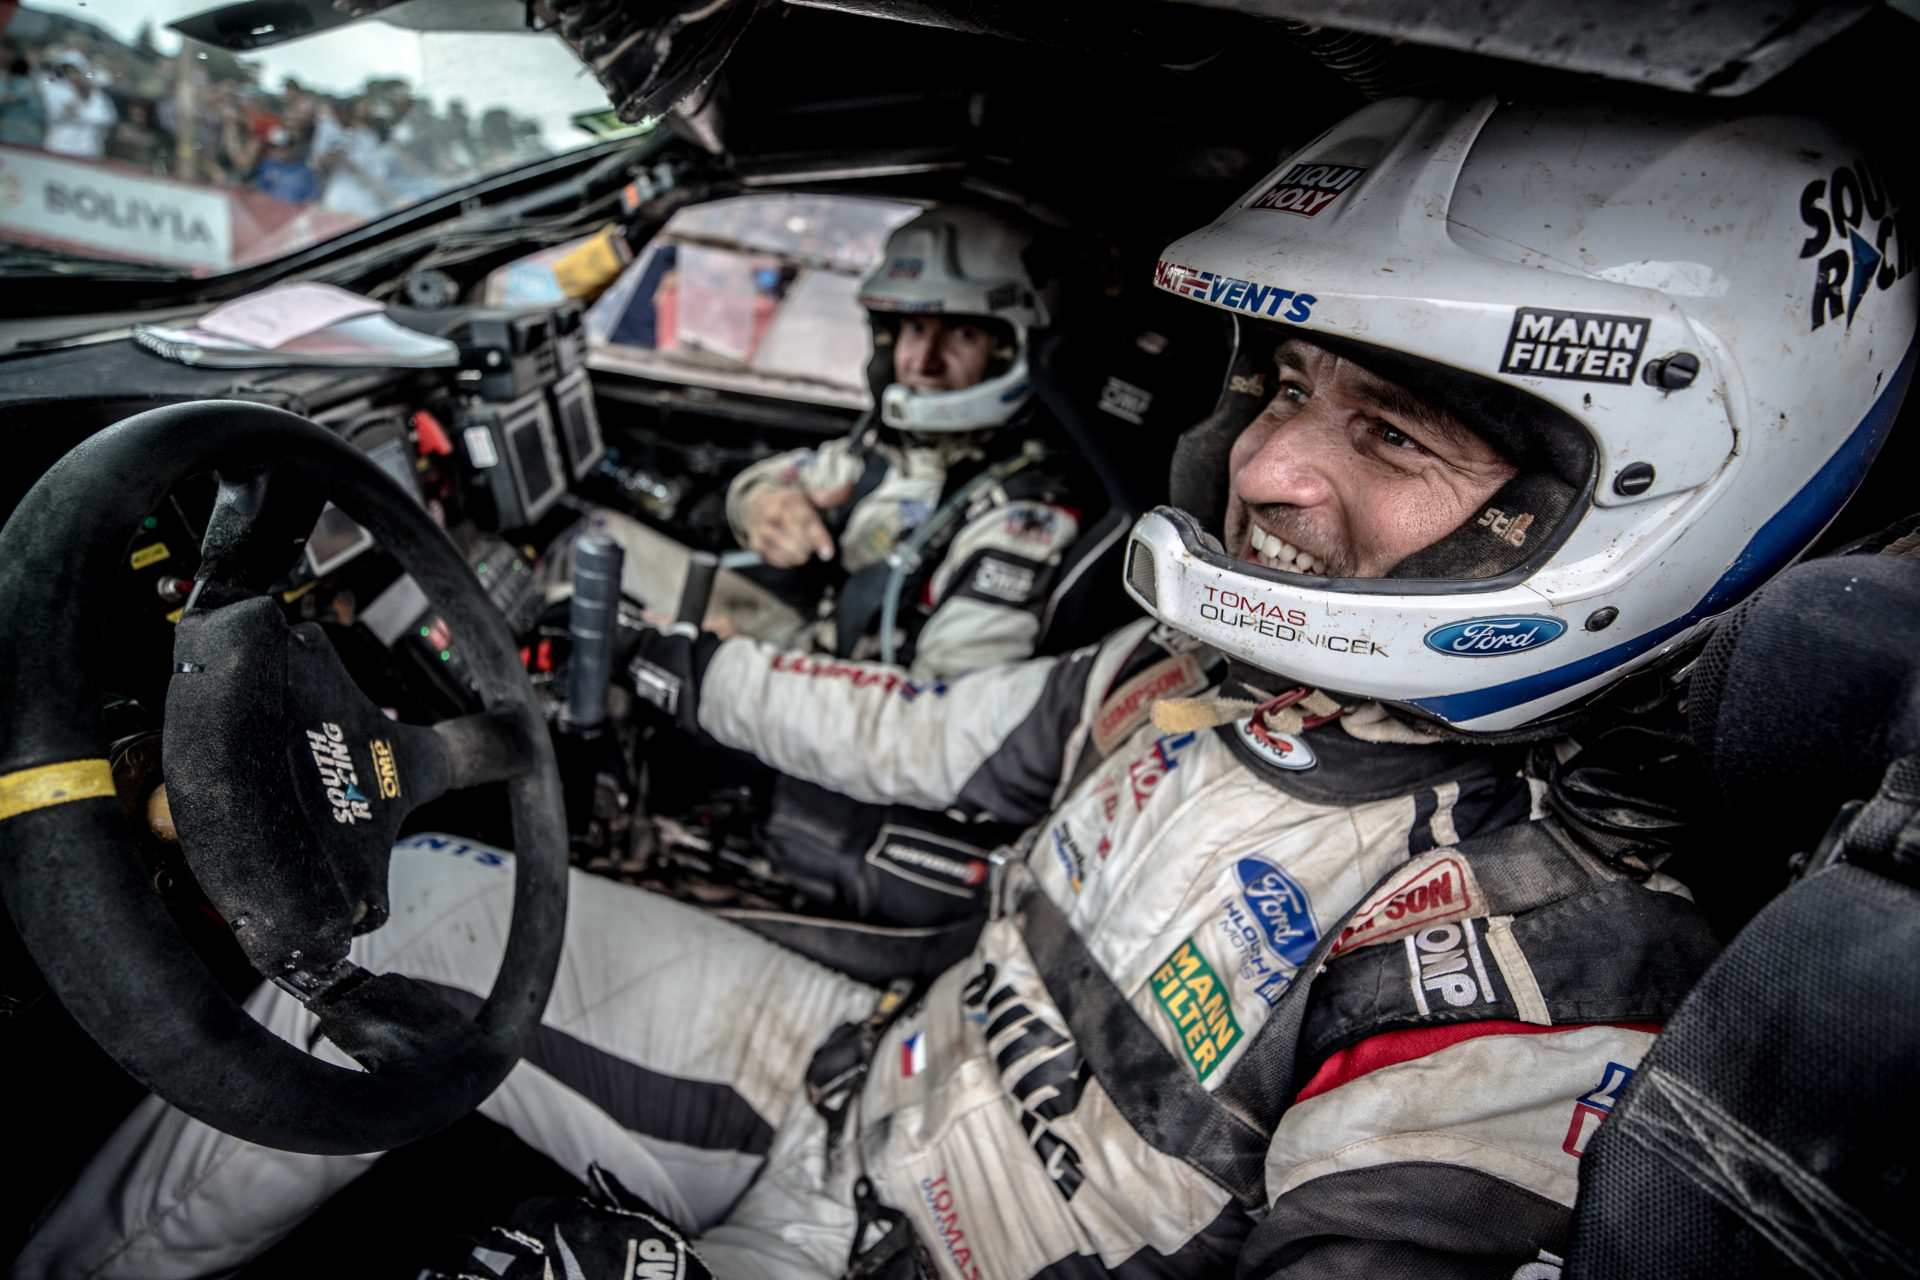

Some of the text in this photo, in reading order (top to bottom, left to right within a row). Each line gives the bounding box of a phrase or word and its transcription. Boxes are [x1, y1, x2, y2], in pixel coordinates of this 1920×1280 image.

[1255, 187, 1336, 213] MOLY
[1280, 165, 1361, 190] LIQUI
[44, 179, 214, 246] BOLIVIA
[1508, 341, 1633, 379] FILTER
[1516, 314, 1643, 350] MANN
[1205, 585, 1306, 627] TOMAS
[1453, 622, 1541, 651] Ford
[1101, 666, 1187, 739] SIMPSON
[306, 730, 355, 824] SOUTH
[374, 739, 397, 799] OMP
[1246, 872, 1304, 945] Ford
[1415, 923, 1478, 1008] OMP
[1152, 962, 1217, 1074] FILTER
[1171, 943, 1236, 1052] MANN
